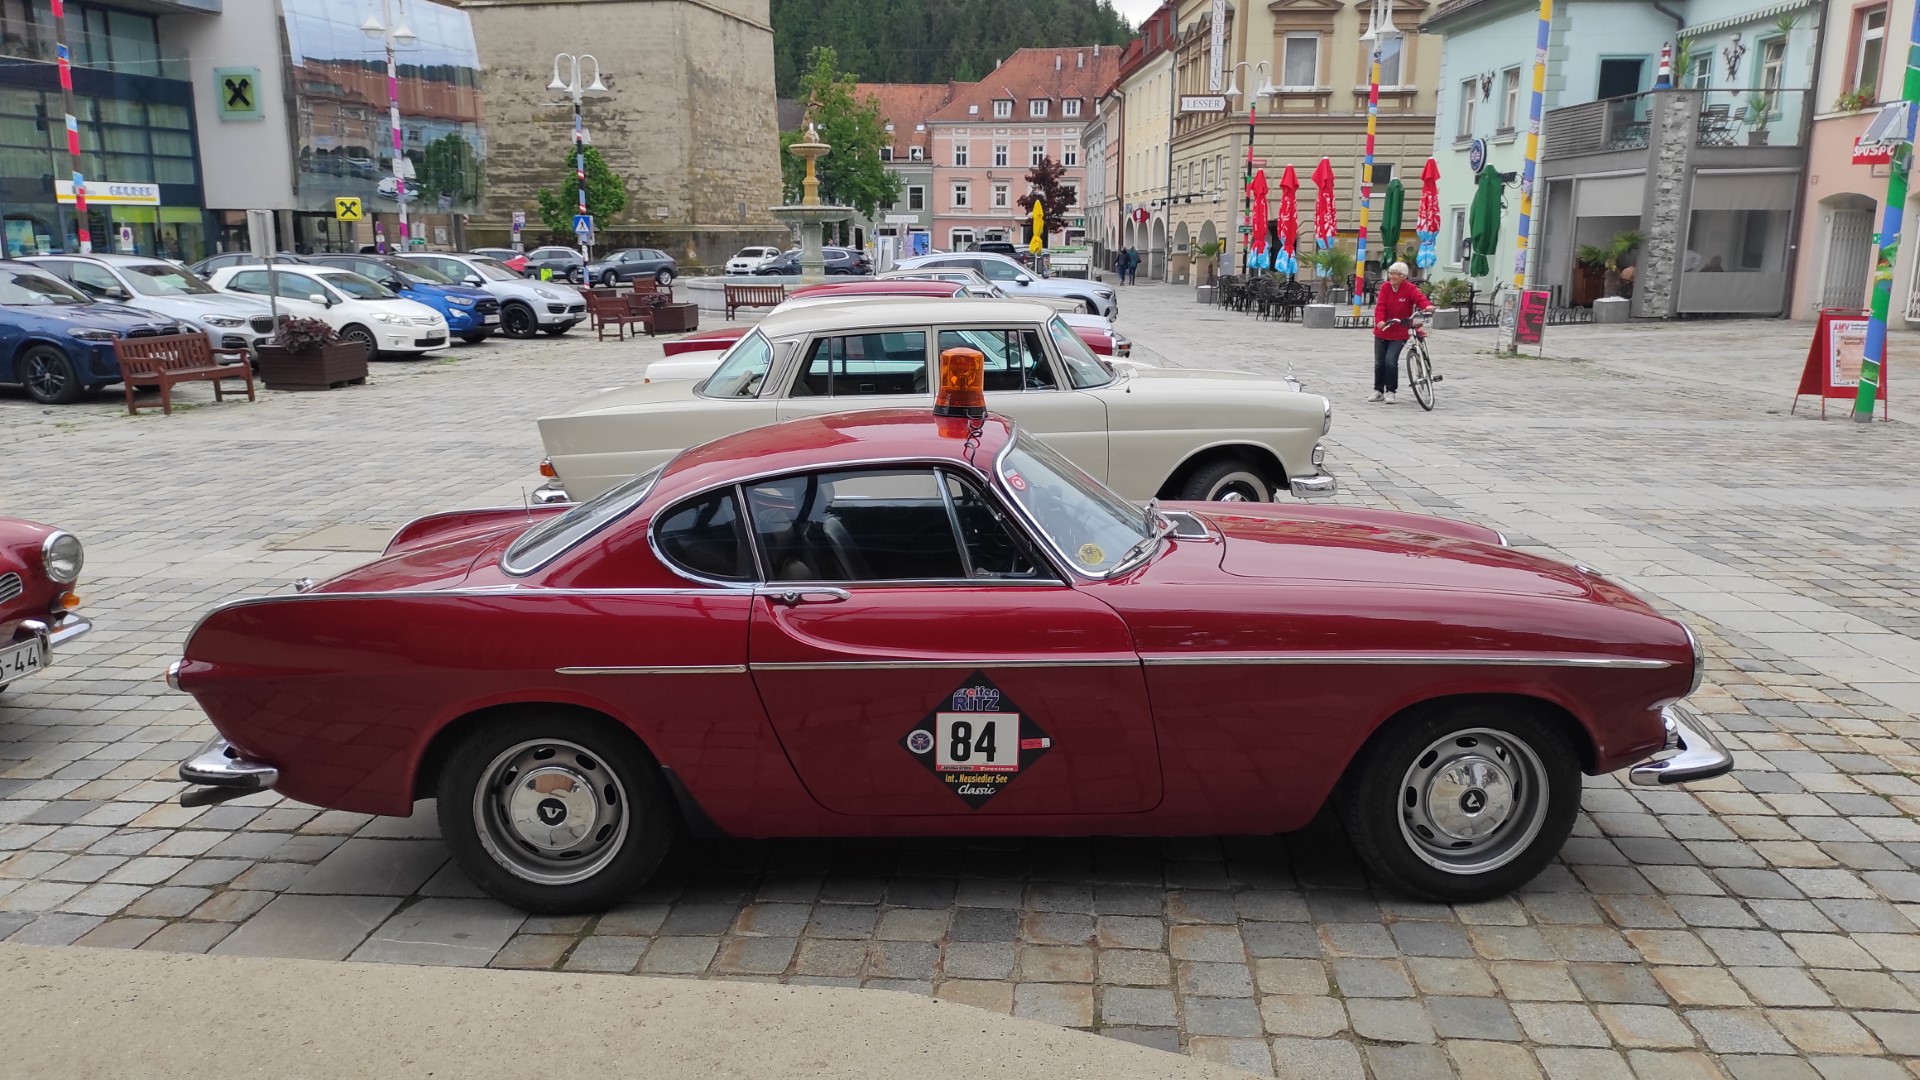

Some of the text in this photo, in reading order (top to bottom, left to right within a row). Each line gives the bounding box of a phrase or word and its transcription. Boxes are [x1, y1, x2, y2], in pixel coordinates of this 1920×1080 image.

[1186, 99, 1220, 109] LESSER
[109, 185, 152, 196] GRUBER
[1833, 322, 1850, 331] AMV
[953, 696, 999, 711] RITZ
[951, 721, 996, 762] 84
[959, 773, 995, 783] Neusiedler
[995, 774, 1008, 783] See
[958, 784, 996, 795] Classic
